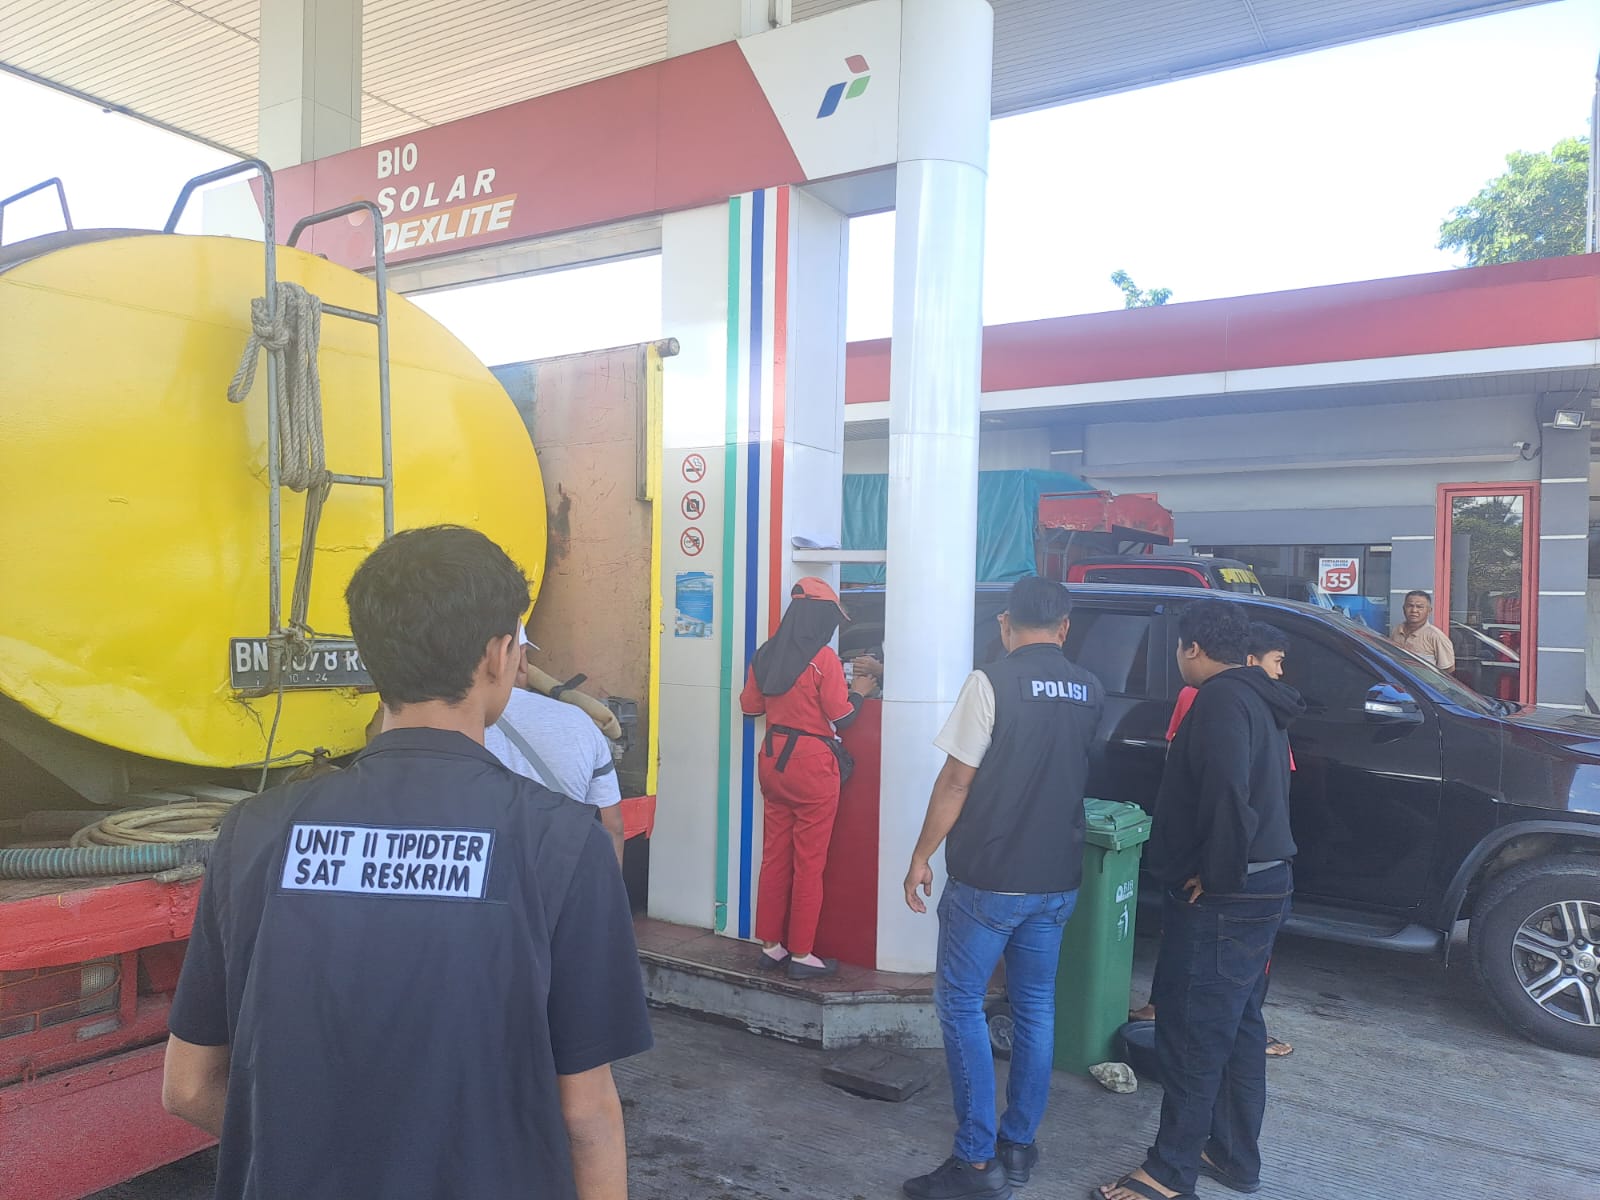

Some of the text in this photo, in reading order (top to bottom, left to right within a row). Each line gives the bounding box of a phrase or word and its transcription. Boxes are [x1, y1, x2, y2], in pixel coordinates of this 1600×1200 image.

[377, 143, 418, 179] BIO
[377, 168, 496, 218] SOLAR
[373, 200, 515, 257] DEXLITE
[1321, 572, 1351, 588] 135
[235, 642, 268, 672] BN
[1031, 680, 1087, 702] POLISI
[295, 828, 484, 862] UNIT II TIPIDTER
[295, 858, 470, 892] SAT RESKRIM
